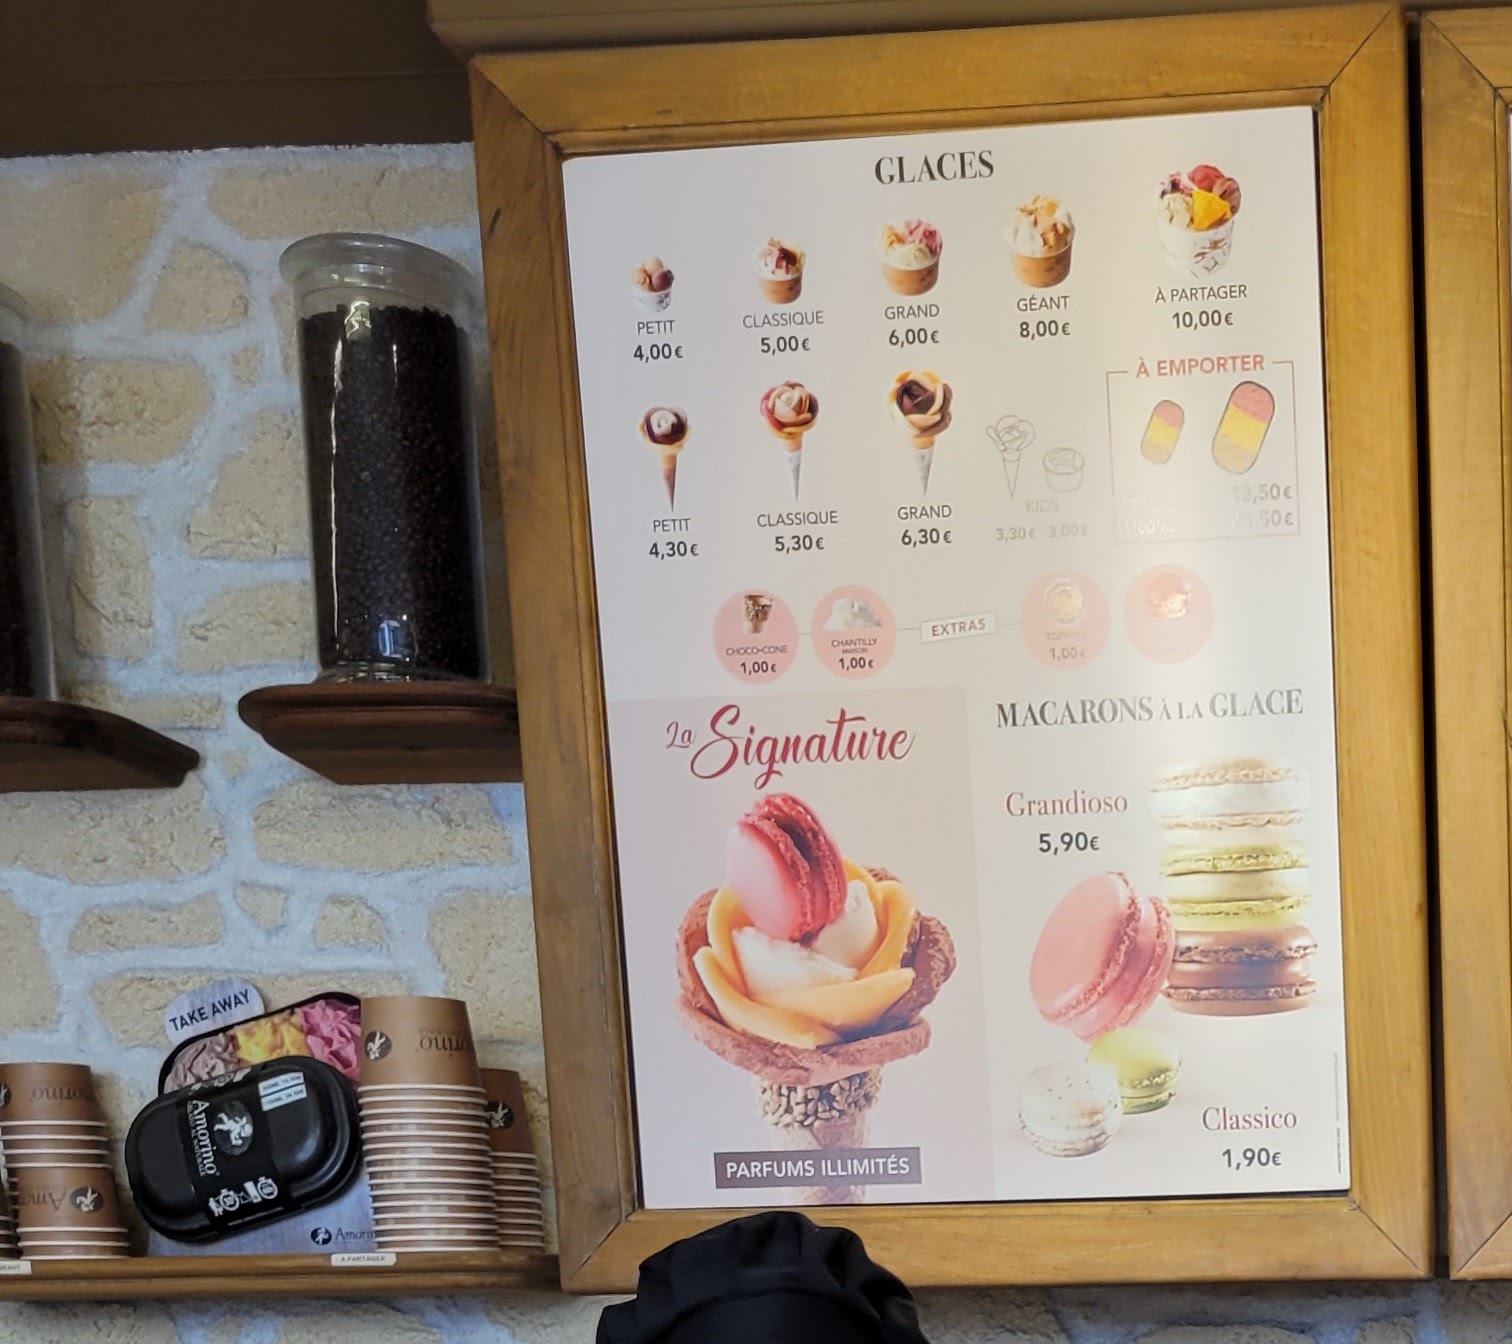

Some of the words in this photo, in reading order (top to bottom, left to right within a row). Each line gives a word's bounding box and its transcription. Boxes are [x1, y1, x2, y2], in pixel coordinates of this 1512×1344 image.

[874, 150, 994, 185] GLACES
[1017, 295, 1070, 313] GÉANT
[1155, 287, 1166, 303] À
[1171, 285, 1247, 302] PARTAGER
[743, 311, 824, 329] CLASSIQUE
[884, 304, 940, 320] GRAND
[637, 320, 676, 335] PETIT
[1136, 357, 1149, 378] À
[1157, 355, 1265, 376] EMPORTER
[757, 511, 838, 528] CLASSIQUE
[897, 505, 952, 521] GRAND
[653, 518, 691, 533] PETIT
[931, 619, 986, 637] EXTRAS
[996, 696, 1153, 728] MACARONS
[1209, 688, 1303, 718] GLACE
[665, 721, 696, 749] La
[690, 704, 916, 790] Signature
[1005, 790, 1128, 817] Grandioso
[1038, 832, 1100, 855] 5,90€
[169, 1006, 209, 1032] TAKE
[211, 989, 251, 1014] AWAY
[1202, 1107, 1297, 1132] Classico
[192, 1099, 217, 1175] Amorino
[725, 1159, 814, 1181] PARFUMS
[821, 1155, 910, 1177] ILLIMITÉS
[1221, 1148, 1283, 1171] 1,90€
